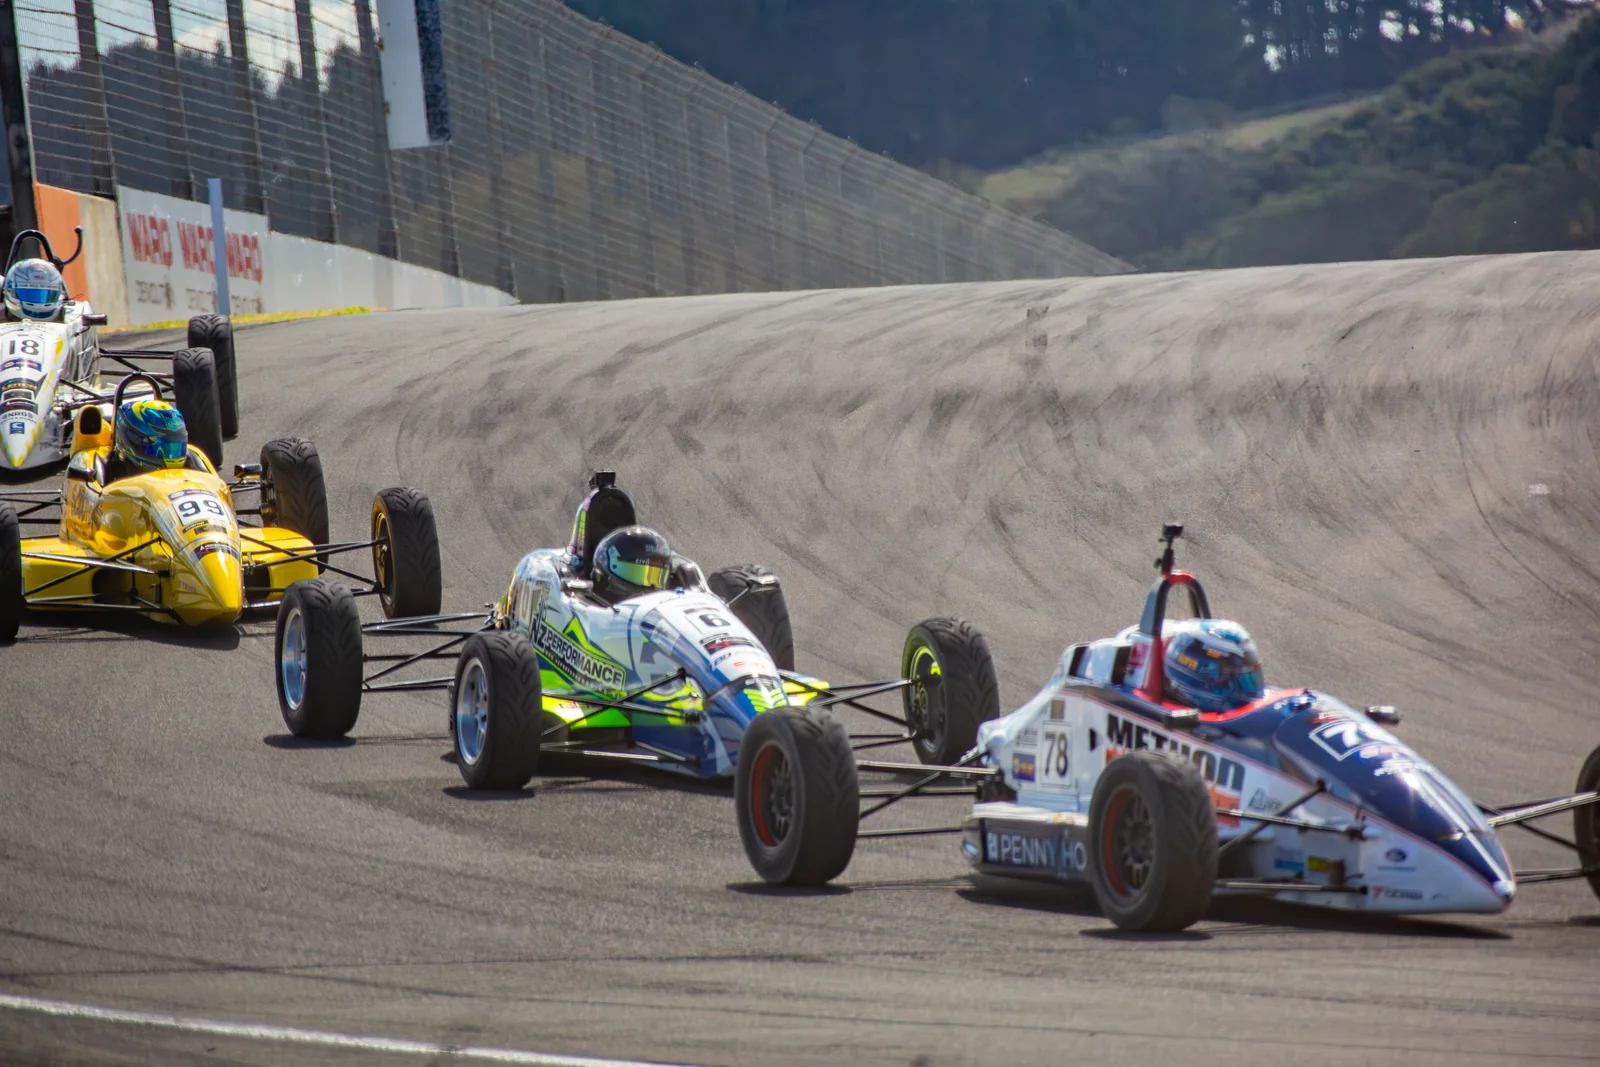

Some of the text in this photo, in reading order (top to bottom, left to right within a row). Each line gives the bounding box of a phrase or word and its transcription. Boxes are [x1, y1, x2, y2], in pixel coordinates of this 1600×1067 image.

[9, 340, 39, 355] 18
[178, 500, 224, 517] 99
[699, 614, 731, 627] 6
[546, 631, 623, 686] PERFORMANCE
[1044, 731, 1068, 777] 78
[1001, 833, 1056, 867] PENNY
